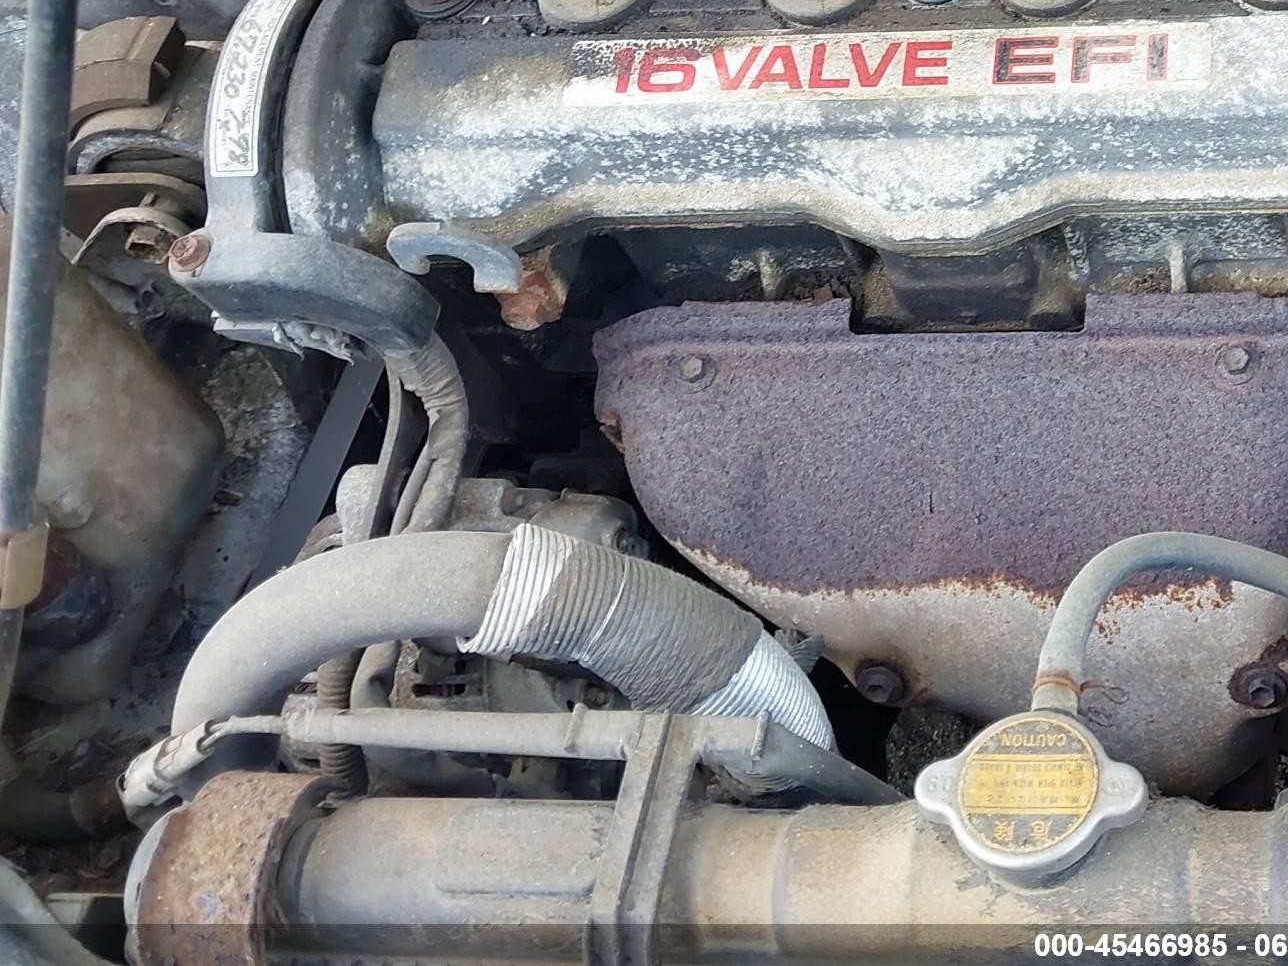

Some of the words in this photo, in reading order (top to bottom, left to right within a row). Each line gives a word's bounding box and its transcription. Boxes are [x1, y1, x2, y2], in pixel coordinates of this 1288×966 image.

[614, 45, 699, 94] 16
[711, 41, 953, 91] VALVE
[993, 34, 1169, 85] EFI
[1000, 733, 1067, 748] CAUTION
